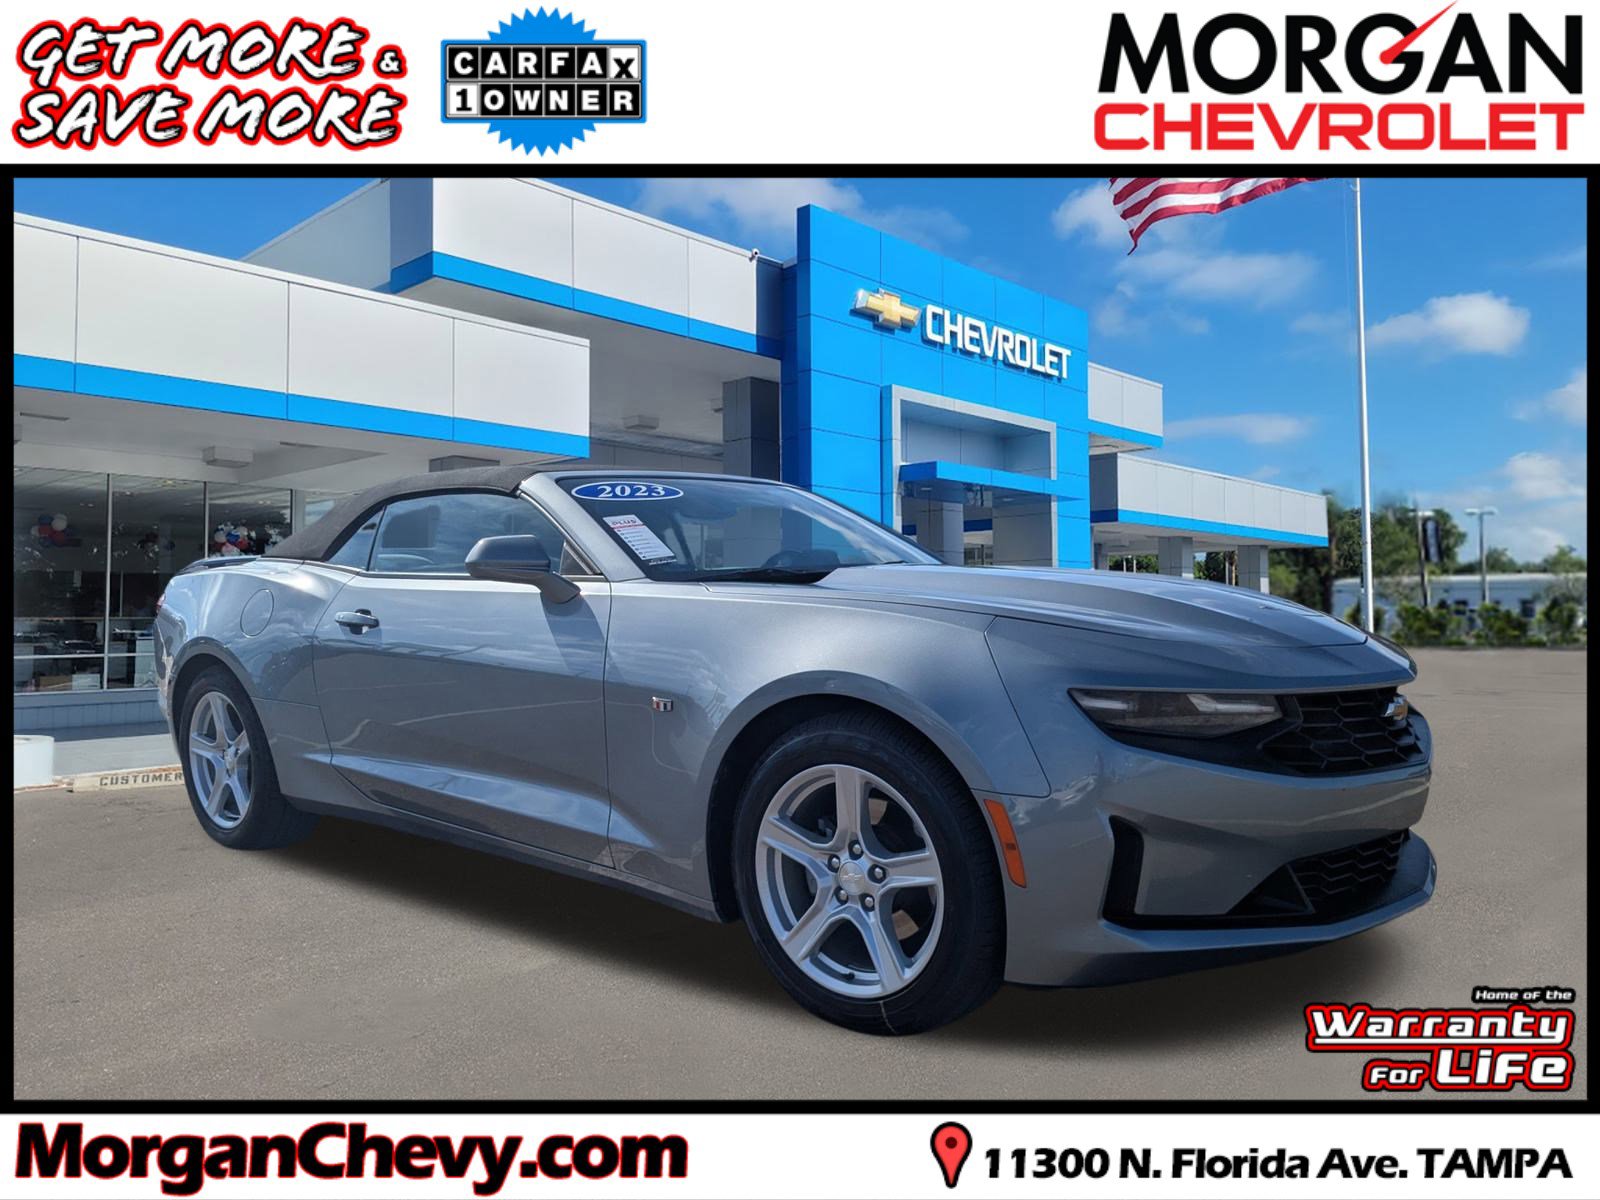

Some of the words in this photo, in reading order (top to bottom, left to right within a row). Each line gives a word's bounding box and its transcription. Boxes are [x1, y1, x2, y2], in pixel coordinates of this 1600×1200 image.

[925, 304, 1072, 379] CHEVROLET
[597, 485, 666, 498] 2023
[99, 772, 184, 786] CUSTOMER
